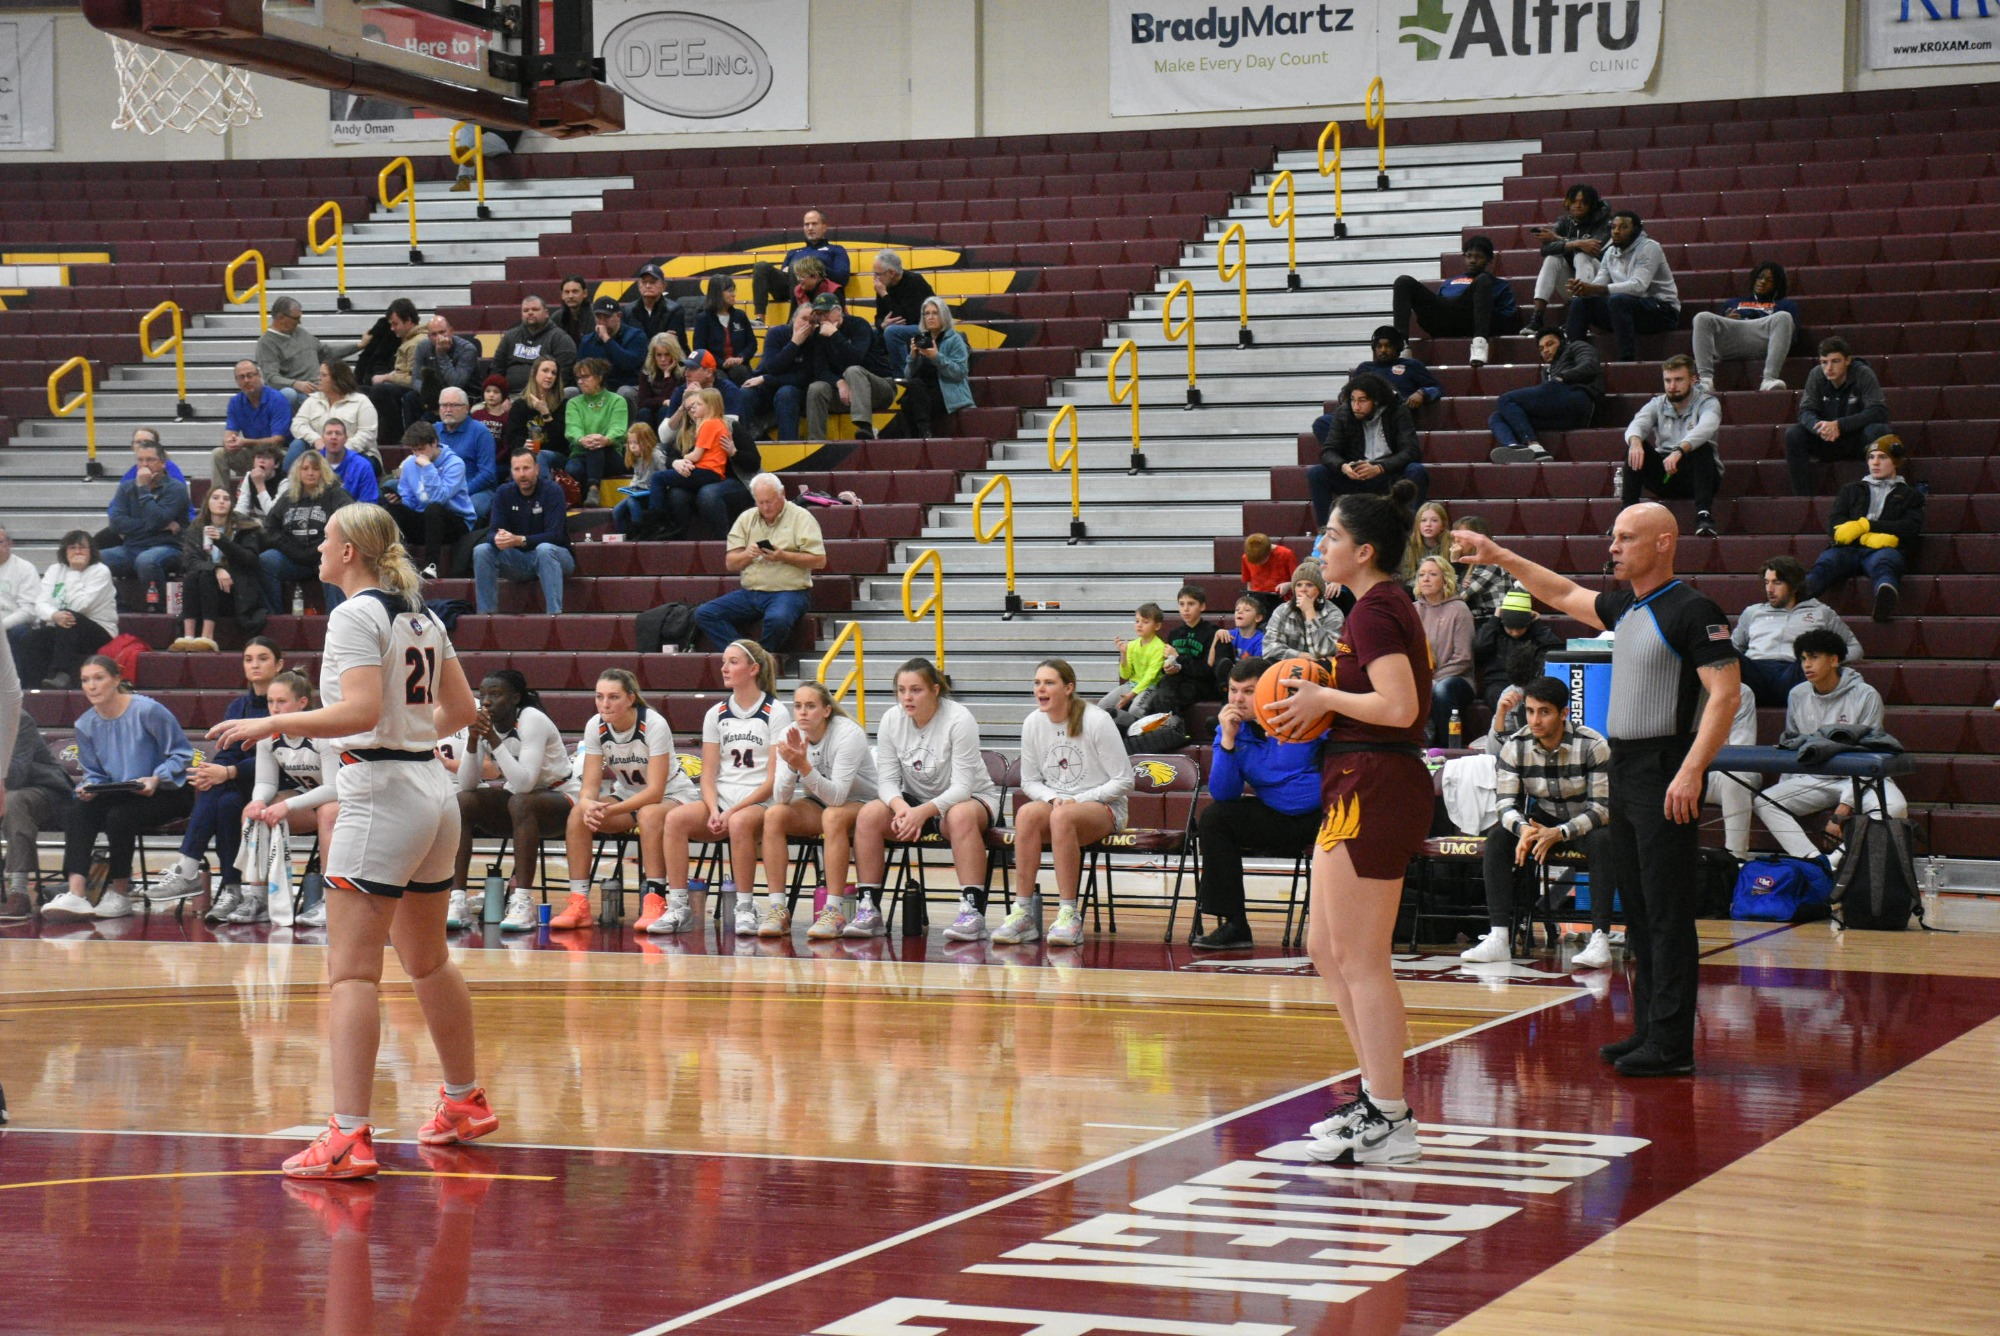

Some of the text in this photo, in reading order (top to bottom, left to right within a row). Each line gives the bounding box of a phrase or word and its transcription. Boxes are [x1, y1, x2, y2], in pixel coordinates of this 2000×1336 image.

[1131, 3, 1354, 48] BradyMartz
[404, 37, 448, 55] Here
[452, 36, 470, 55] to
[1893, 40, 1992, 54] www.KROXAM.com
[623, 38, 707, 78] DEE
[1154, 51, 1329, 74] Make Every Day Count
[1590, 58, 1640, 73] CLINIC
[334, 122, 395, 136] Andy Oman
[405, 646, 435, 705] 21
[722, 730, 764, 746] Marauders
[730, 748, 755, 768] 24
[620, 769, 648, 786] 14
[1101, 833, 1137, 846] UMC
[1439, 842, 1478, 855] UMC
